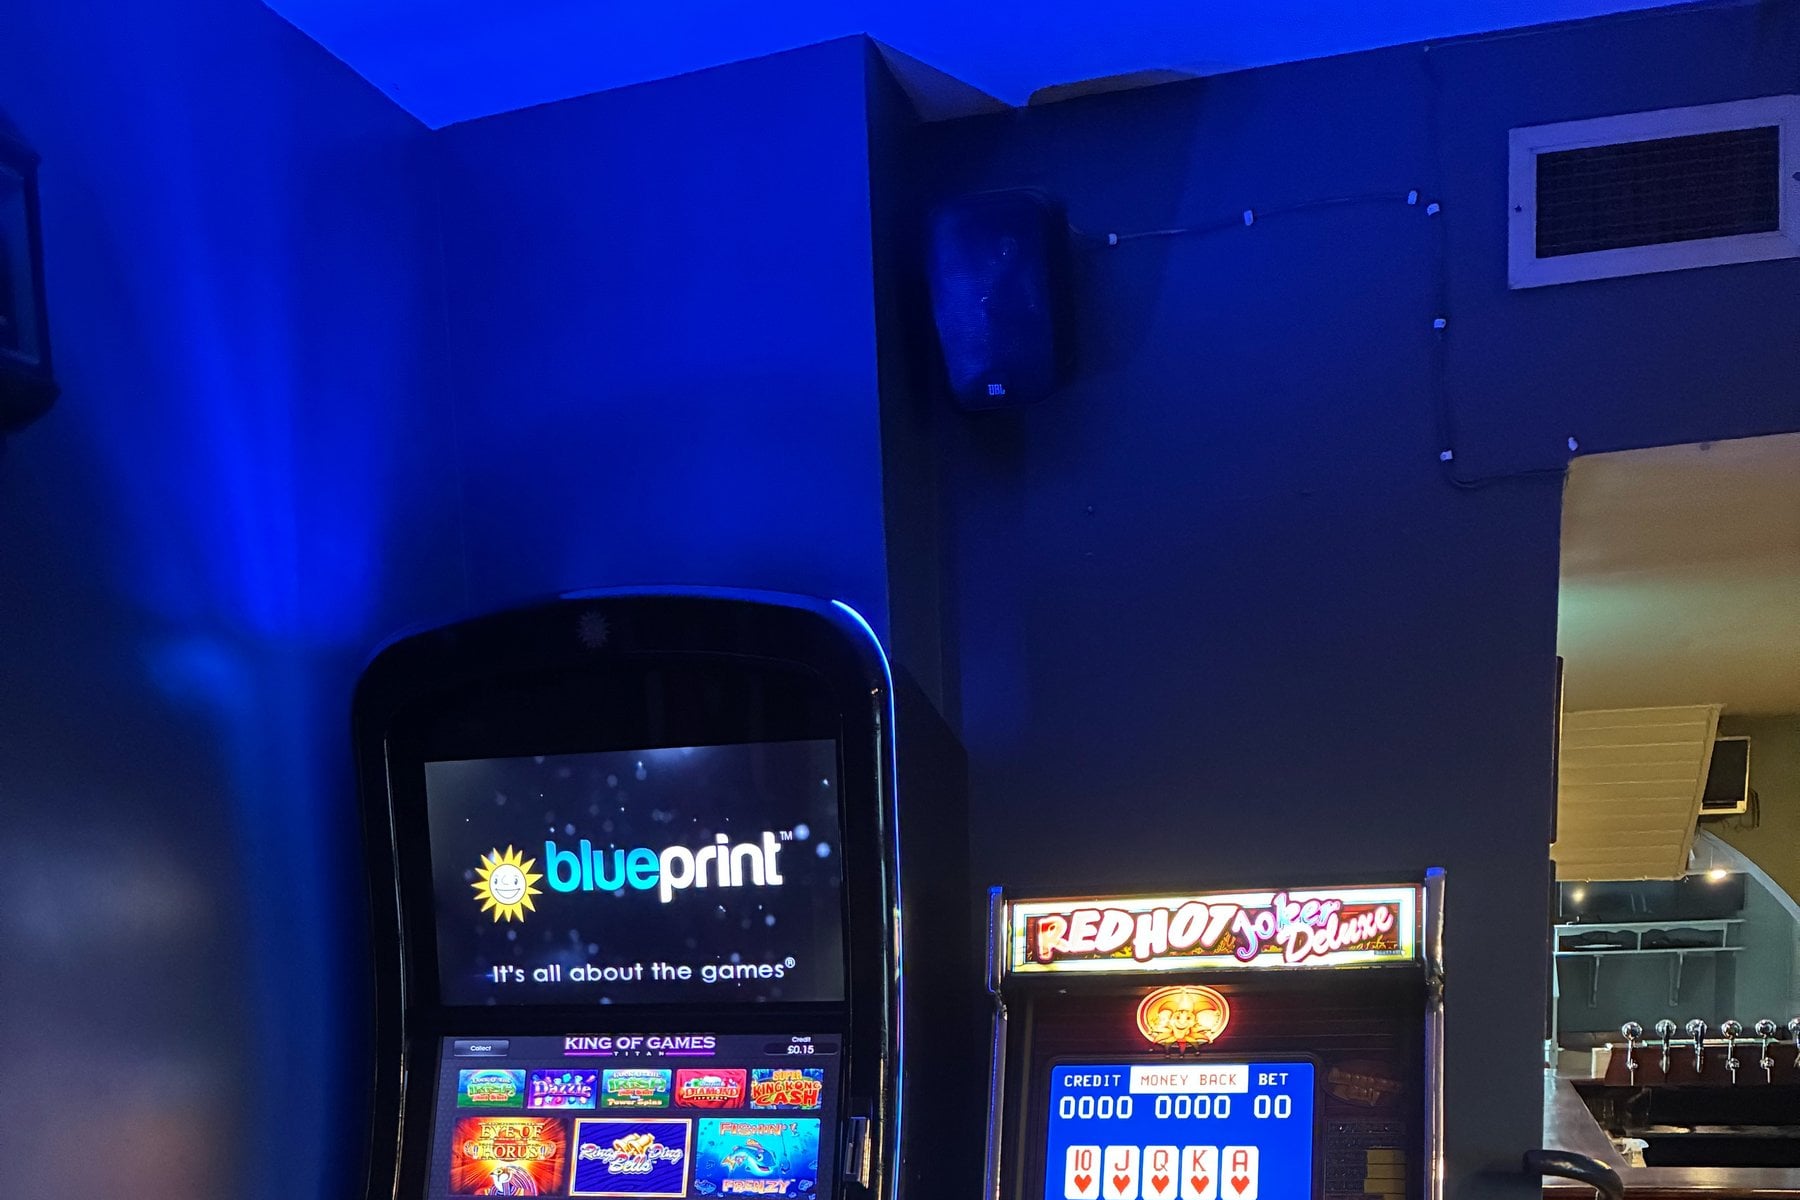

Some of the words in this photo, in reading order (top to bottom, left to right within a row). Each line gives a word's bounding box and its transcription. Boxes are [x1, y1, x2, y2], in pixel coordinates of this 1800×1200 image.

[545, 831, 783, 903] blueprint
[1037, 907, 1135, 964] RED
[1133, 900, 1240, 963] HOT
[1232, 890, 1344, 962] Joker
[1277, 905, 1395, 964] Deluxe
[493, 965, 525, 983] It's
[533, 964, 561, 983] all
[569, 963, 644, 983] about
[651, 962, 692, 981] the
[565, 1037, 612, 1050] KING
[616, 1037, 644, 1050] OF
[646, 1036, 716, 1049] GAMES
[787, 1045, 814, 1055] £0.15
[533, 1081, 591, 1095] Dazzle
[1064, 1074, 1121, 1087] CREDIT
[1140, 1074, 1189, 1086] MONEY
[1199, 1074, 1237, 1086] BACK
[1258, 1073, 1288, 1086] BET
[752, 1082, 783, 1099] KING
[785, 1080, 822, 1091] KONG
[756, 1089, 819, 1106] CASH
[1059, 1095, 1133, 1119] 0000
[1154, 1095, 1231, 1119] 0000
[1253, 1095, 1291, 1119] 00
[480, 1125, 516, 1139] EYE
[519, 1125, 544, 1139] OF
[481, 1145, 539, 1158] HORUS
[1074, 1149, 1092, 1171] 10
[1114, 1149, 1130, 1171] J
[1153, 1149, 1169, 1172] Q
[1192, 1149, 1206, 1172] K
[1232, 1150, 1248, 1172] A
[722, 1179, 790, 1193] FRENZY
